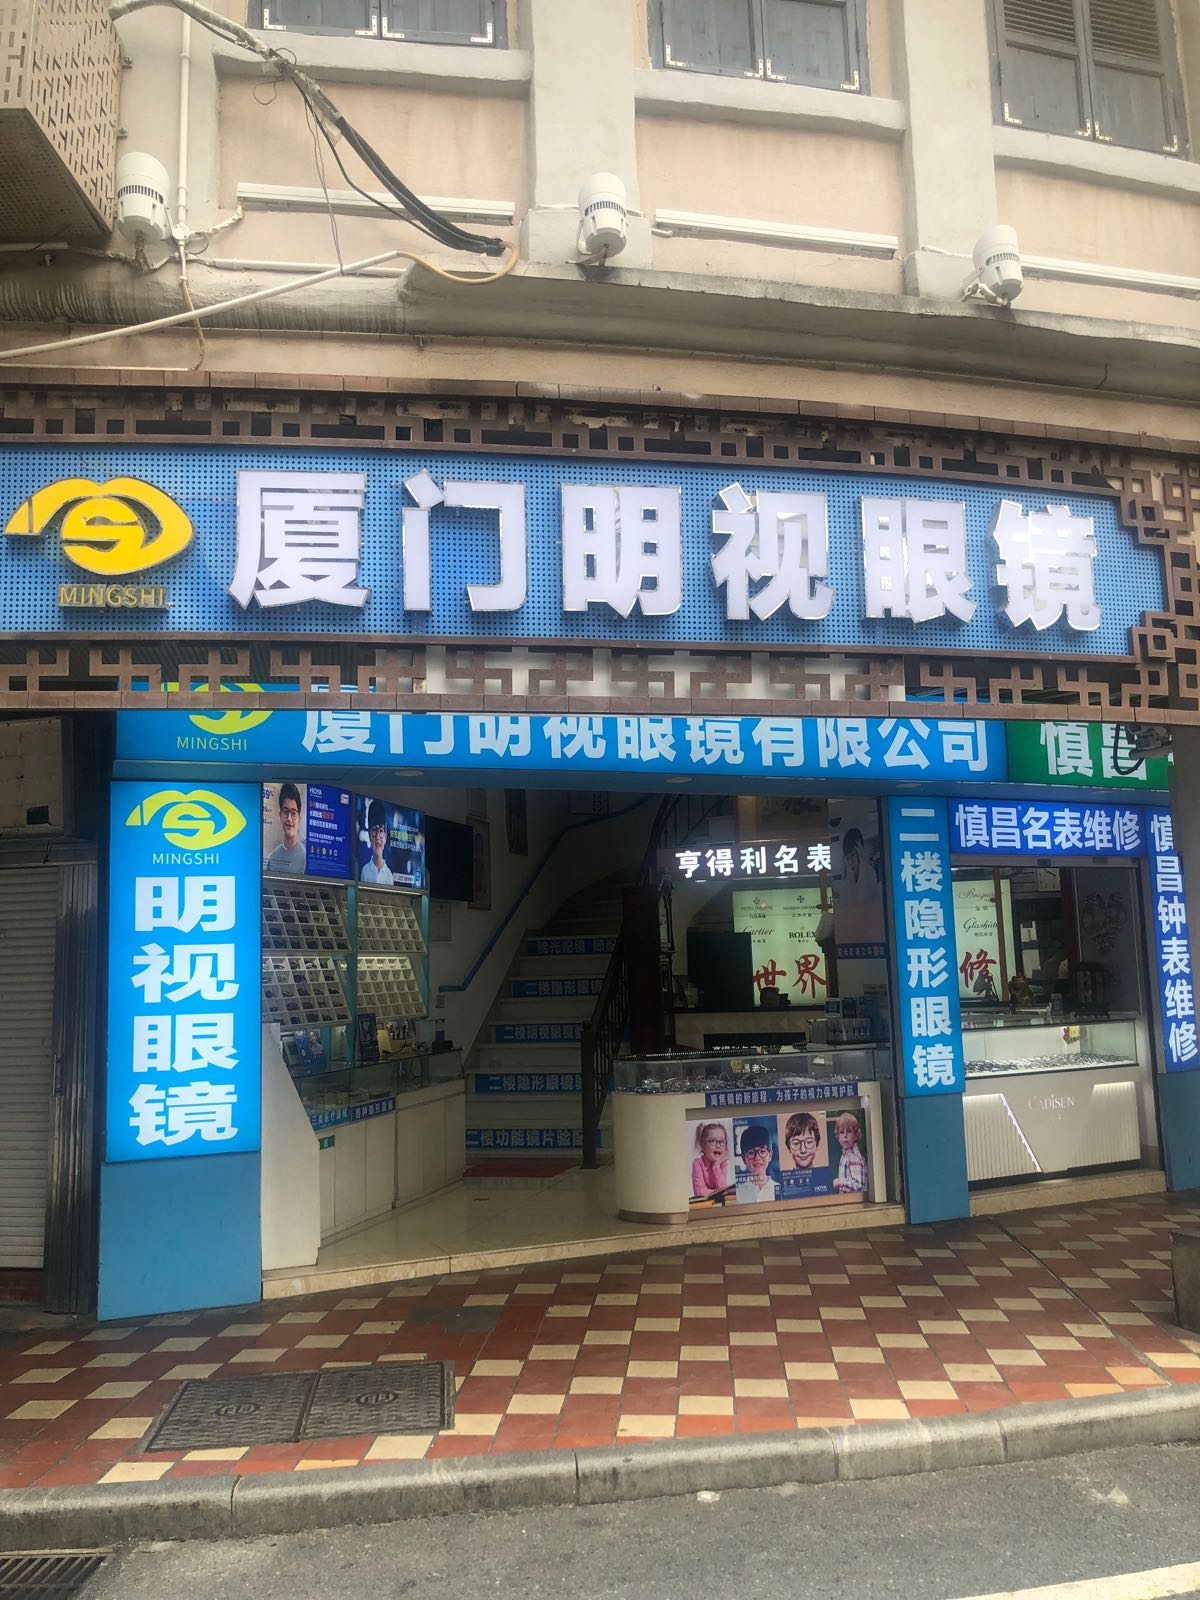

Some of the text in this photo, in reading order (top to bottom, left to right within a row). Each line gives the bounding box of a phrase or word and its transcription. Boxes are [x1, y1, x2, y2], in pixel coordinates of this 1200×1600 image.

[226, 469, 1102, 632] 厦门明视眼镜
[59, 585, 167, 608] MINGSHI
[177, 736, 248, 752] MINGSHI
[301, 709, 988, 772] 厦门明视眼镜有限公司
[1038, 720, 1174, 780] 慎昌
[955, 804, 1142, 852] 慎昌名表维修
[152, 852, 220, 866] MINGSHI
[675, 843, 832, 879] 亨得利名表
[899, 808, 956, 1089] 二楼隐形眼镜
[1150, 813, 1199, 1064] 慎昌钟表维修
[753, 954, 827, 999] 世界
[128, 875, 241, 1147] 明视眼镜
